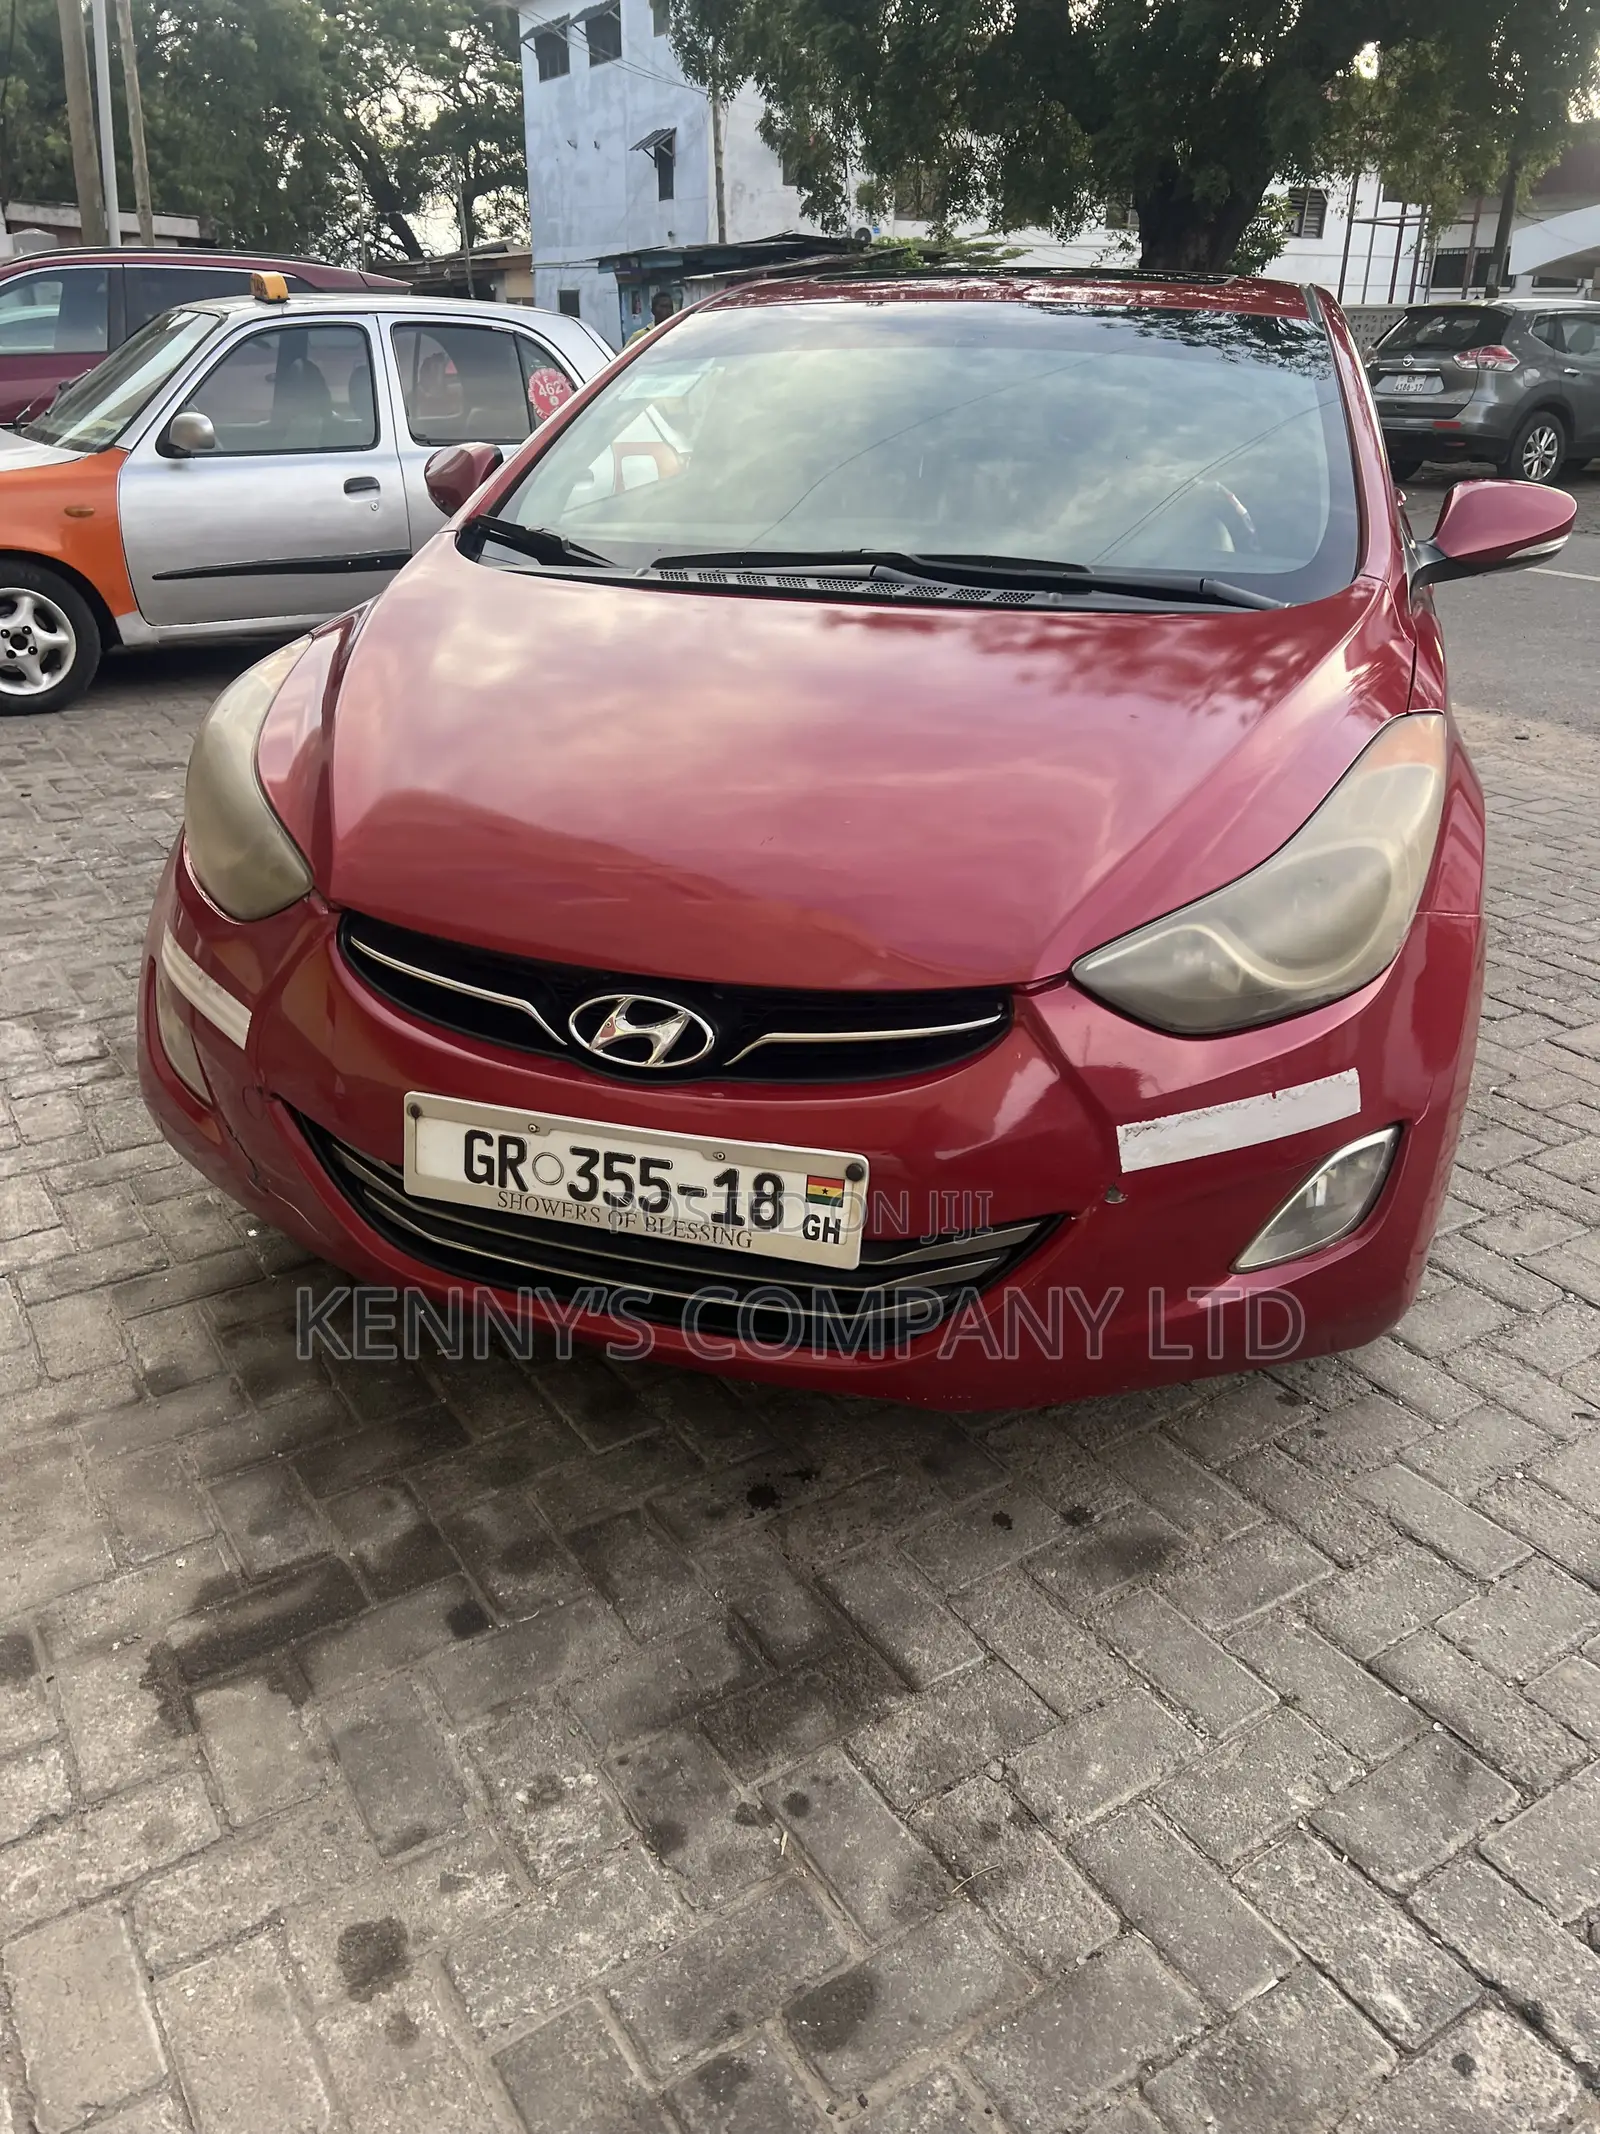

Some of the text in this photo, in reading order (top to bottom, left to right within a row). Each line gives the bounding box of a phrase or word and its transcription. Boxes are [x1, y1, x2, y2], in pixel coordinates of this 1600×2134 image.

[464, 1129, 785, 1231] GR 355-18
[497, 1190, 753, 1249] SHOWERS OF BLESSING
[802, 1213, 842, 1245] GH
